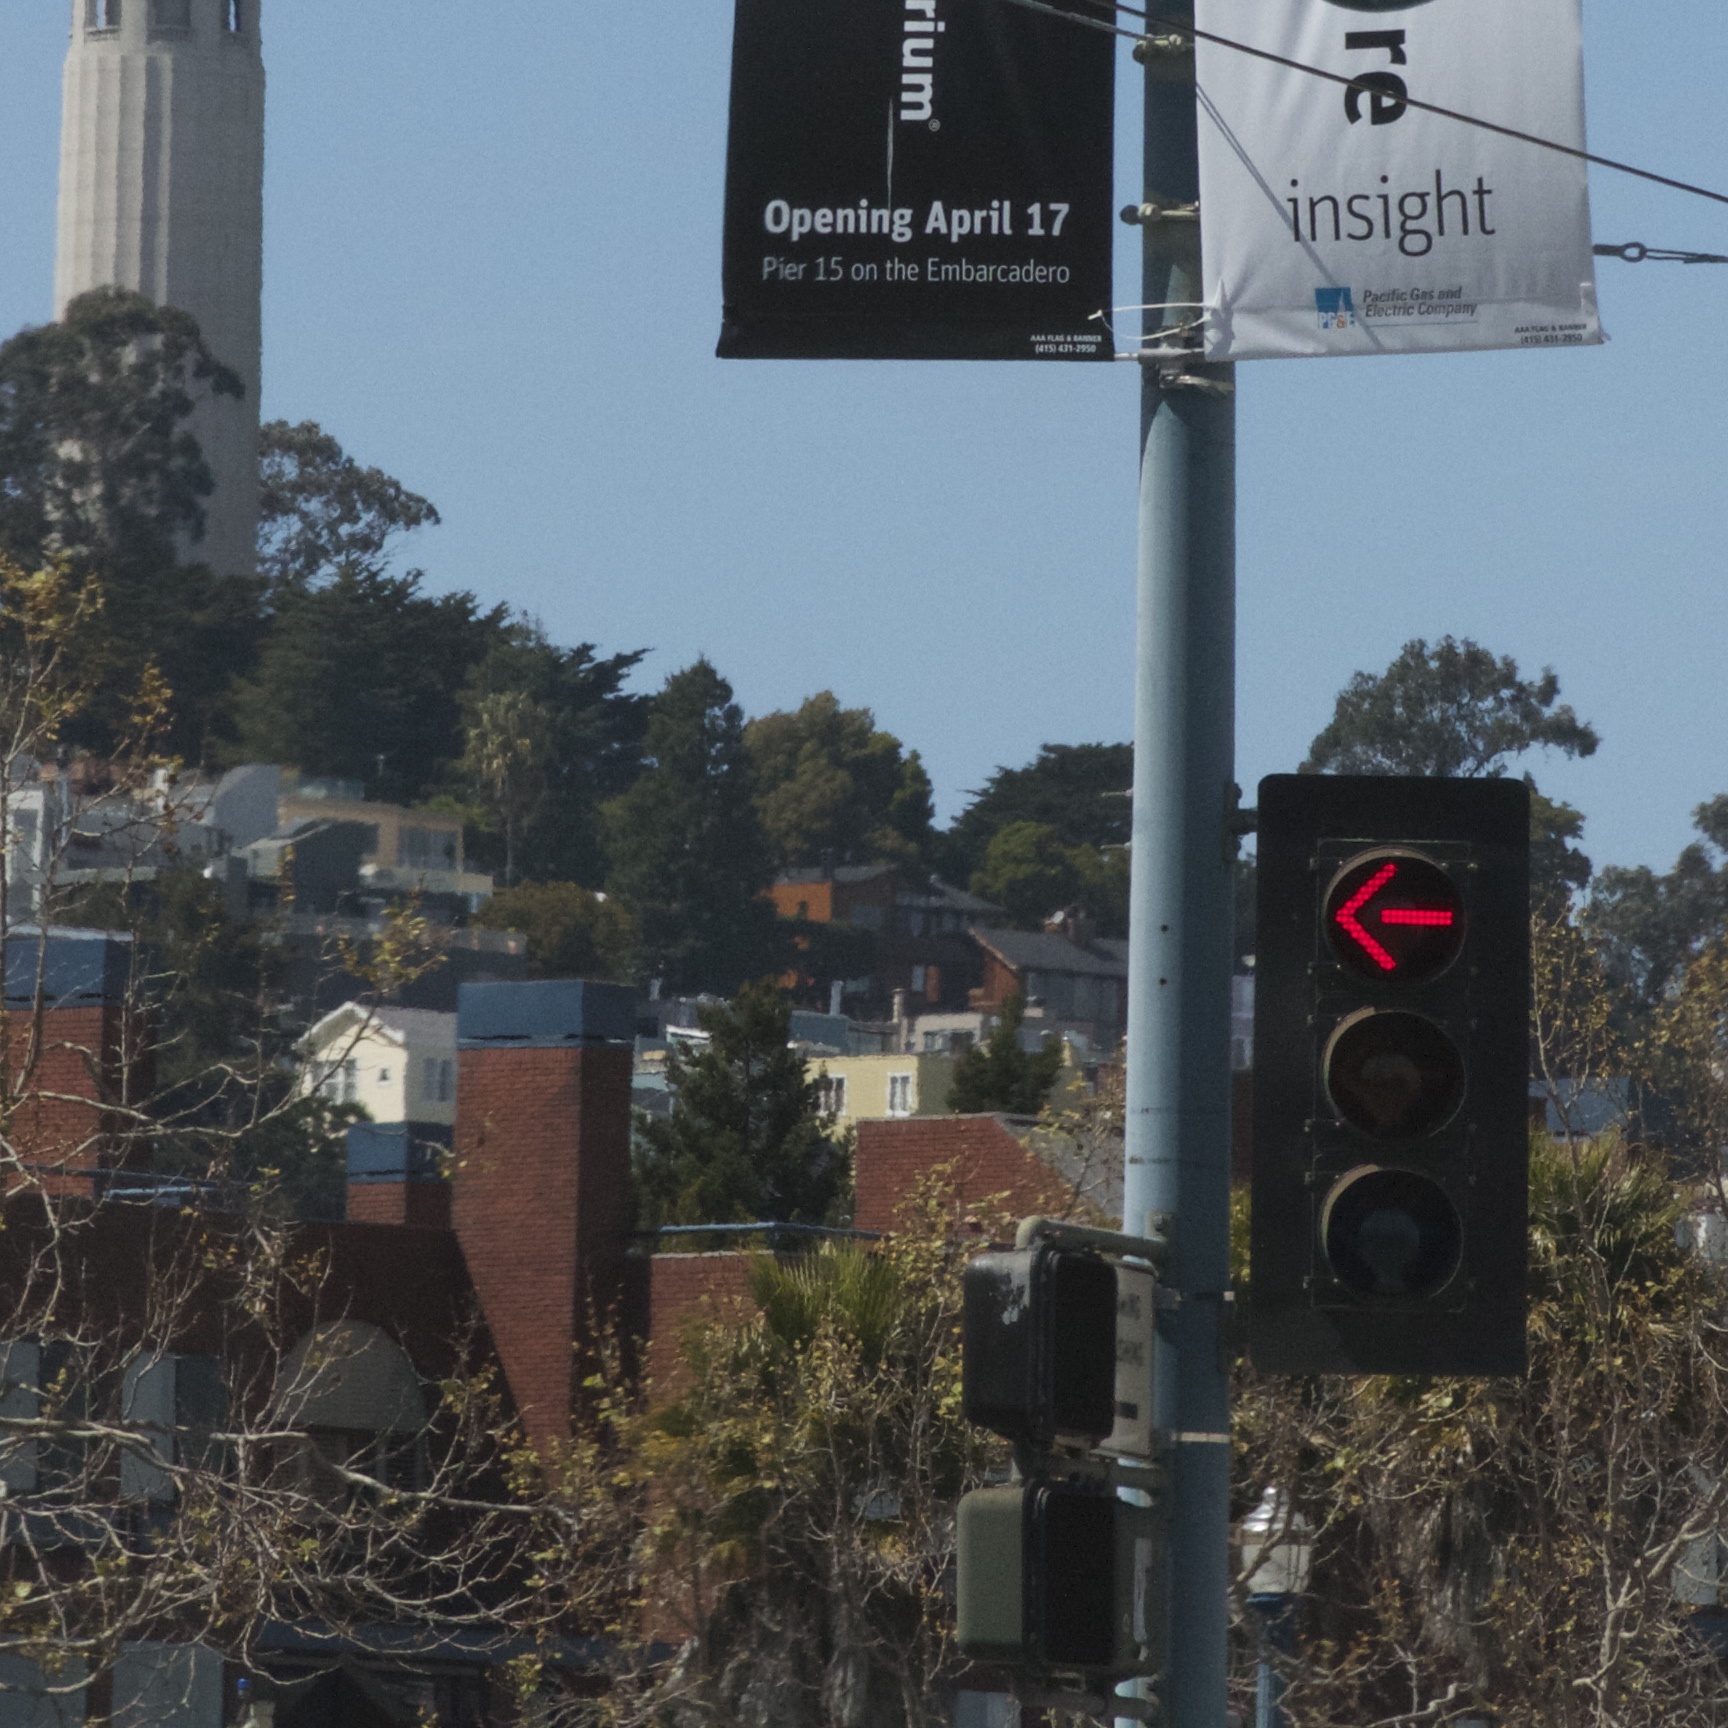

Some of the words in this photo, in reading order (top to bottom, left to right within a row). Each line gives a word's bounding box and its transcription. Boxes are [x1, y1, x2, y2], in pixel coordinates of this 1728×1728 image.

[763, 198, 914, 243] Opening
[924, 199, 1013, 243] April
[1026, 202, 1070, 236] 17
[1287, 168, 1496, 257] insight
[762, 256, 807, 281] Pier
[815, 256, 843, 281] 15
[851, 263, 878, 281] on
[885, 257, 919, 281] the
[927, 257, 1070, 283] Embarcadero
[1363, 288, 1407, 304] Pacific
[1410, 287, 1435, 301] Gas
[1437, 285, 1463, 300] and
[1365, 303, 1415, 318] Electric
[1417, 301, 1478, 318] Company
